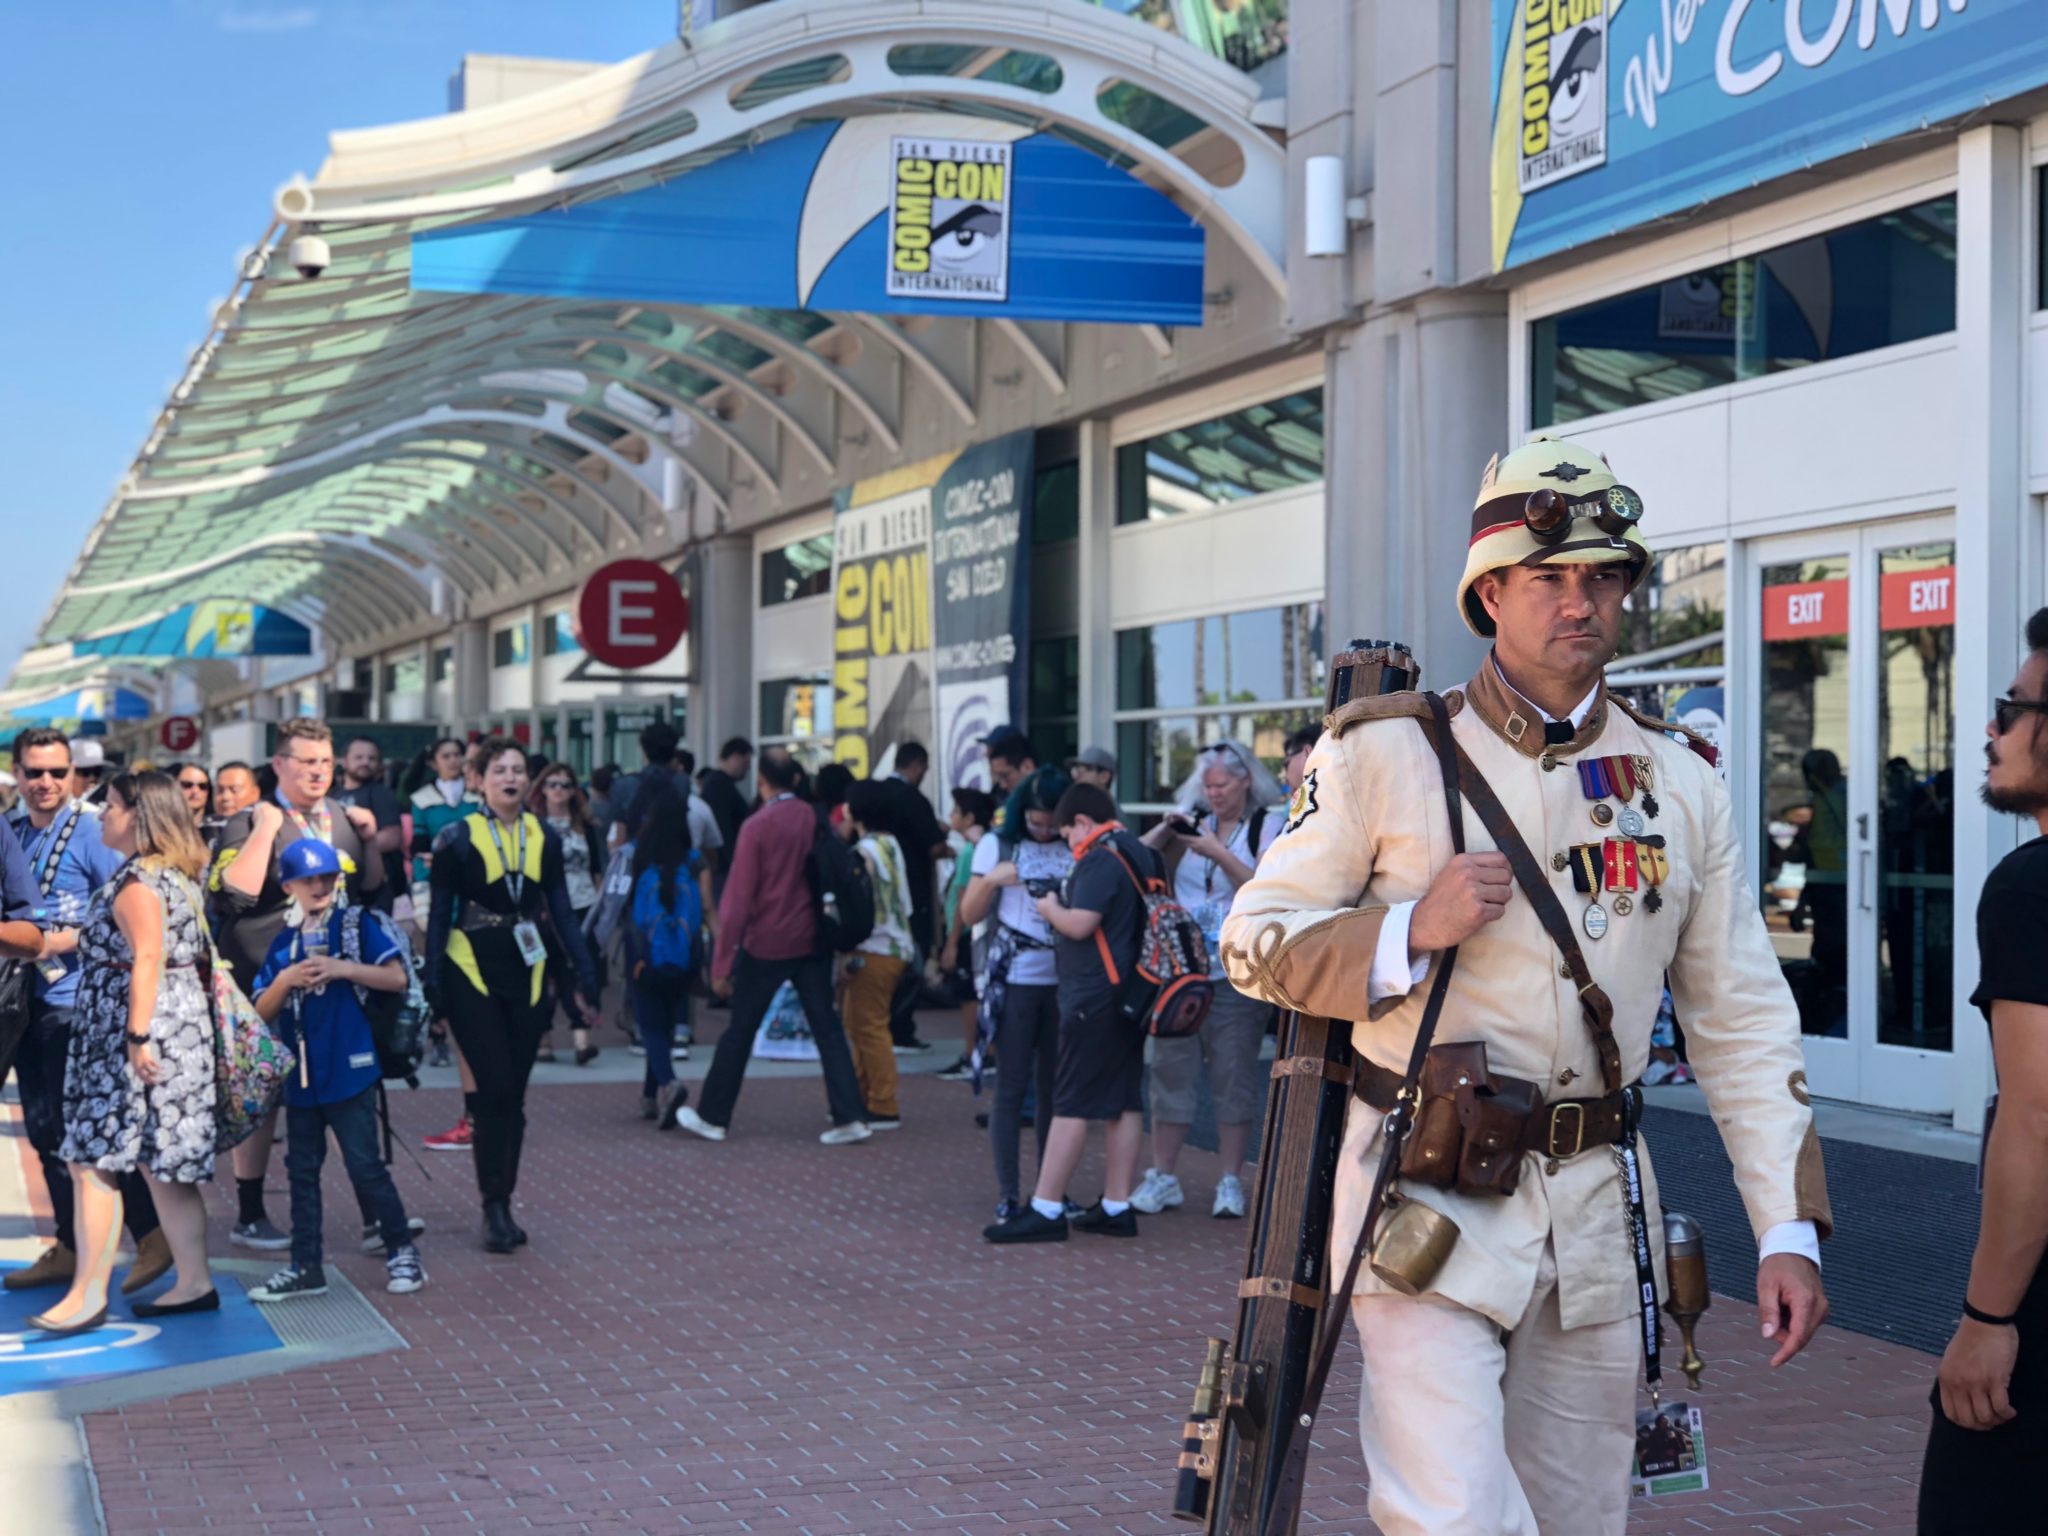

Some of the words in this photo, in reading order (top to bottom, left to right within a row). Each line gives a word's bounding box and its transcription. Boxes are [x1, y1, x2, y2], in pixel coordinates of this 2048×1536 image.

[1523, 0, 1549, 157] COMIC
[897, 142, 931, 157] SAN
[950, 146, 1006, 161] DIEGO
[1523, 138, 1602, 183] INTERNATIONAL
[934, 160, 1004, 202] CON
[894, 159, 934, 272] COMIC
[892, 273, 1001, 293] INTERNATIONAL
[608, 580, 657, 646] E
[870, 551, 930, 657] CON
[1787, 592, 1824, 625] EXIT
[1910, 577, 1950, 613] EXIT
[834, 563, 869, 782] OMIC
[168, 721, 190, 748] F
